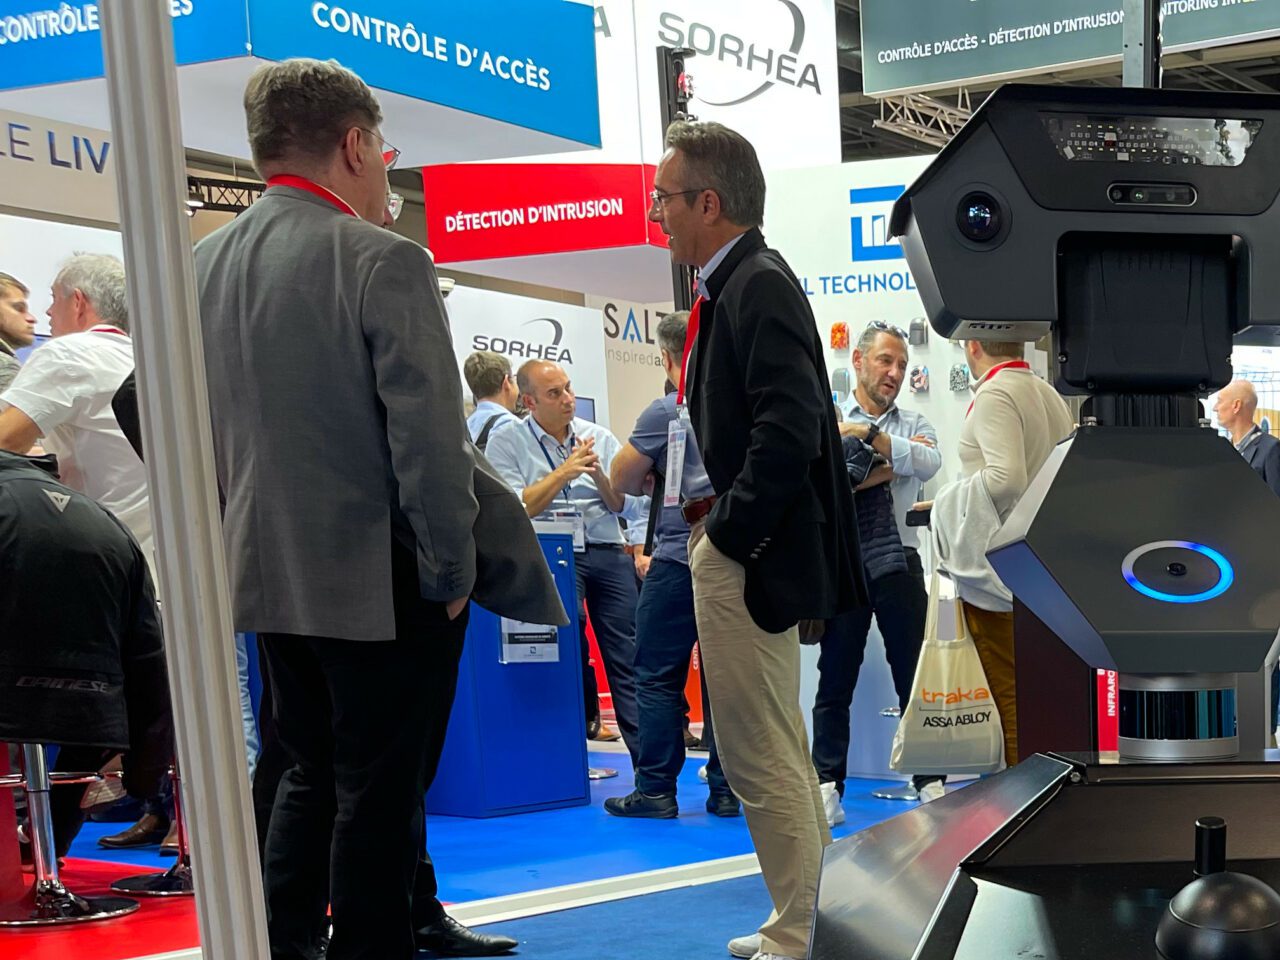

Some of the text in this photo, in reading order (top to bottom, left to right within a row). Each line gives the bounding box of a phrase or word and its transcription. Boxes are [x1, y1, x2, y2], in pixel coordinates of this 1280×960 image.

[311, 1, 552, 92] CONTRÔLE D'ACCÈS
[657, 11, 822, 96] SORHEA
[877, 42, 932, 64] CONTRÔLE
[934, 33, 979, 56] D'ACCÈS
[989, 27, 1050, 47] DÉTECTION
[445, 197, 624, 233] DÉTECTION D'INTRUSION
[472, 334, 573, 365] SORHEA
[922, 687, 990, 705] traka
[923, 711, 992, 727] ASSA ABLOY
